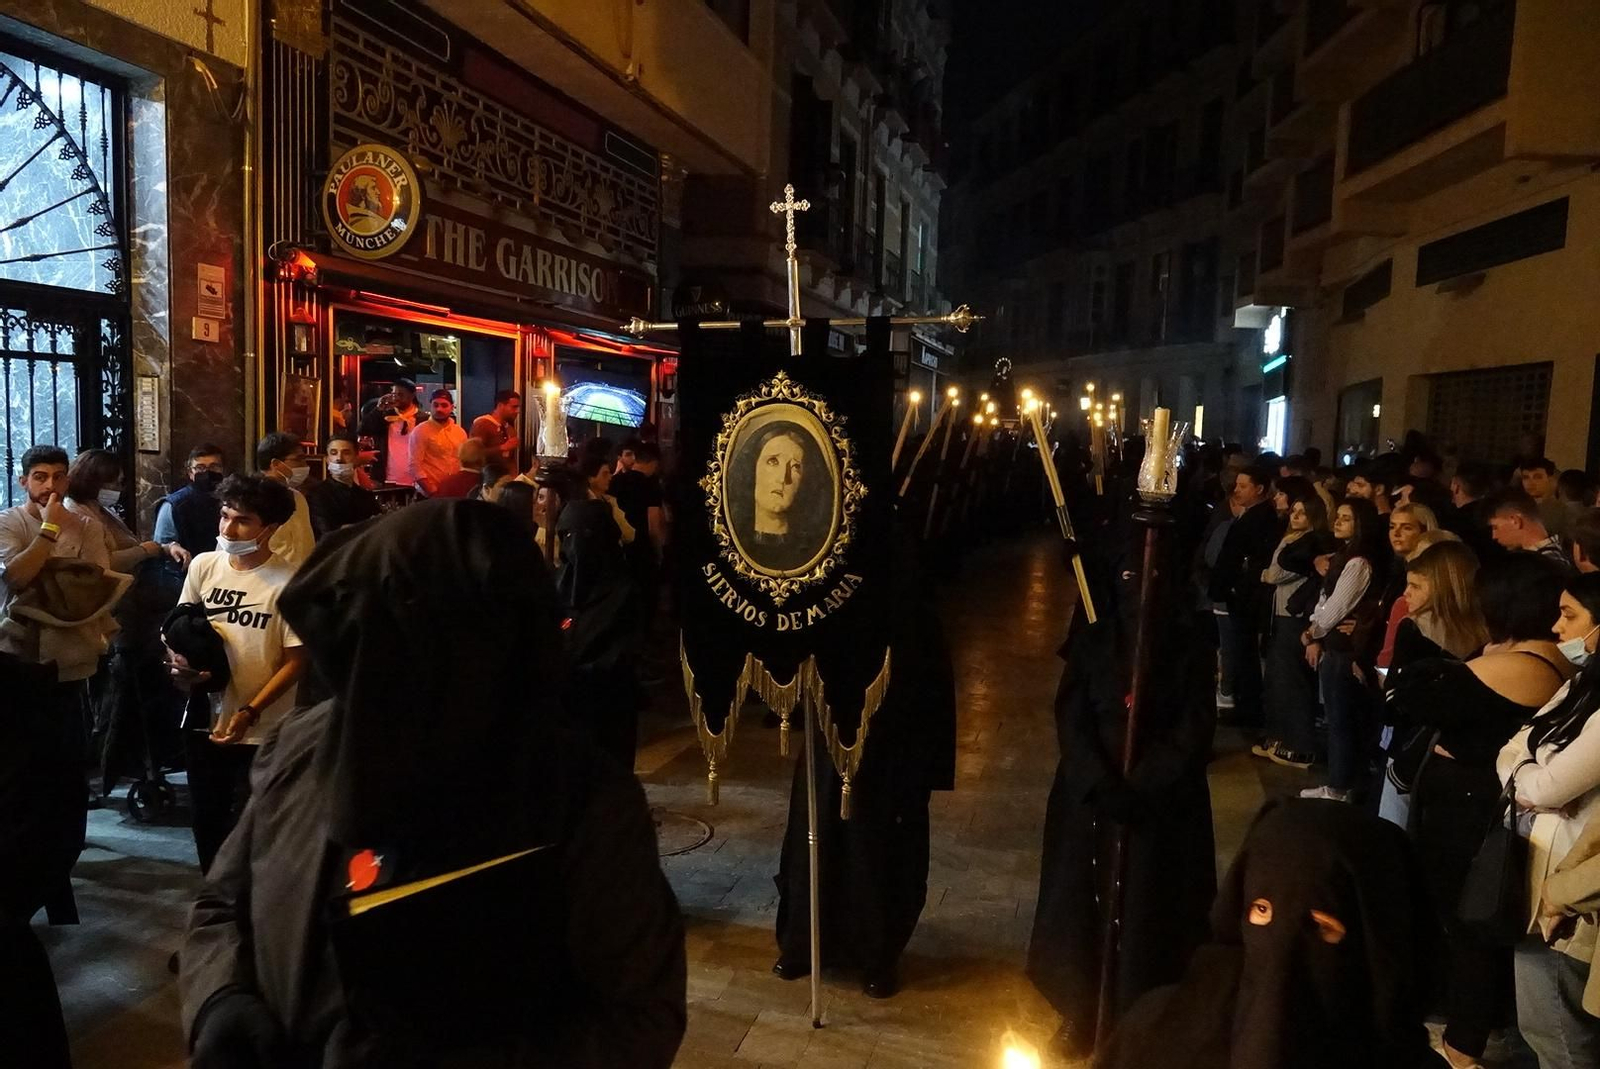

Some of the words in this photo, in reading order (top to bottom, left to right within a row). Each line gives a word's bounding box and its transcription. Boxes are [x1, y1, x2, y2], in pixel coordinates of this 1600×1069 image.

[328, 151, 409, 195] PAULANER
[425, 213, 488, 272] THE
[203, 322, 210, 338] 9
[206, 587, 247, 609] JUST
[701, 562, 769, 628] SIERVOS
[776, 611, 803, 632] DE
[806, 573, 864, 627] MARIA
